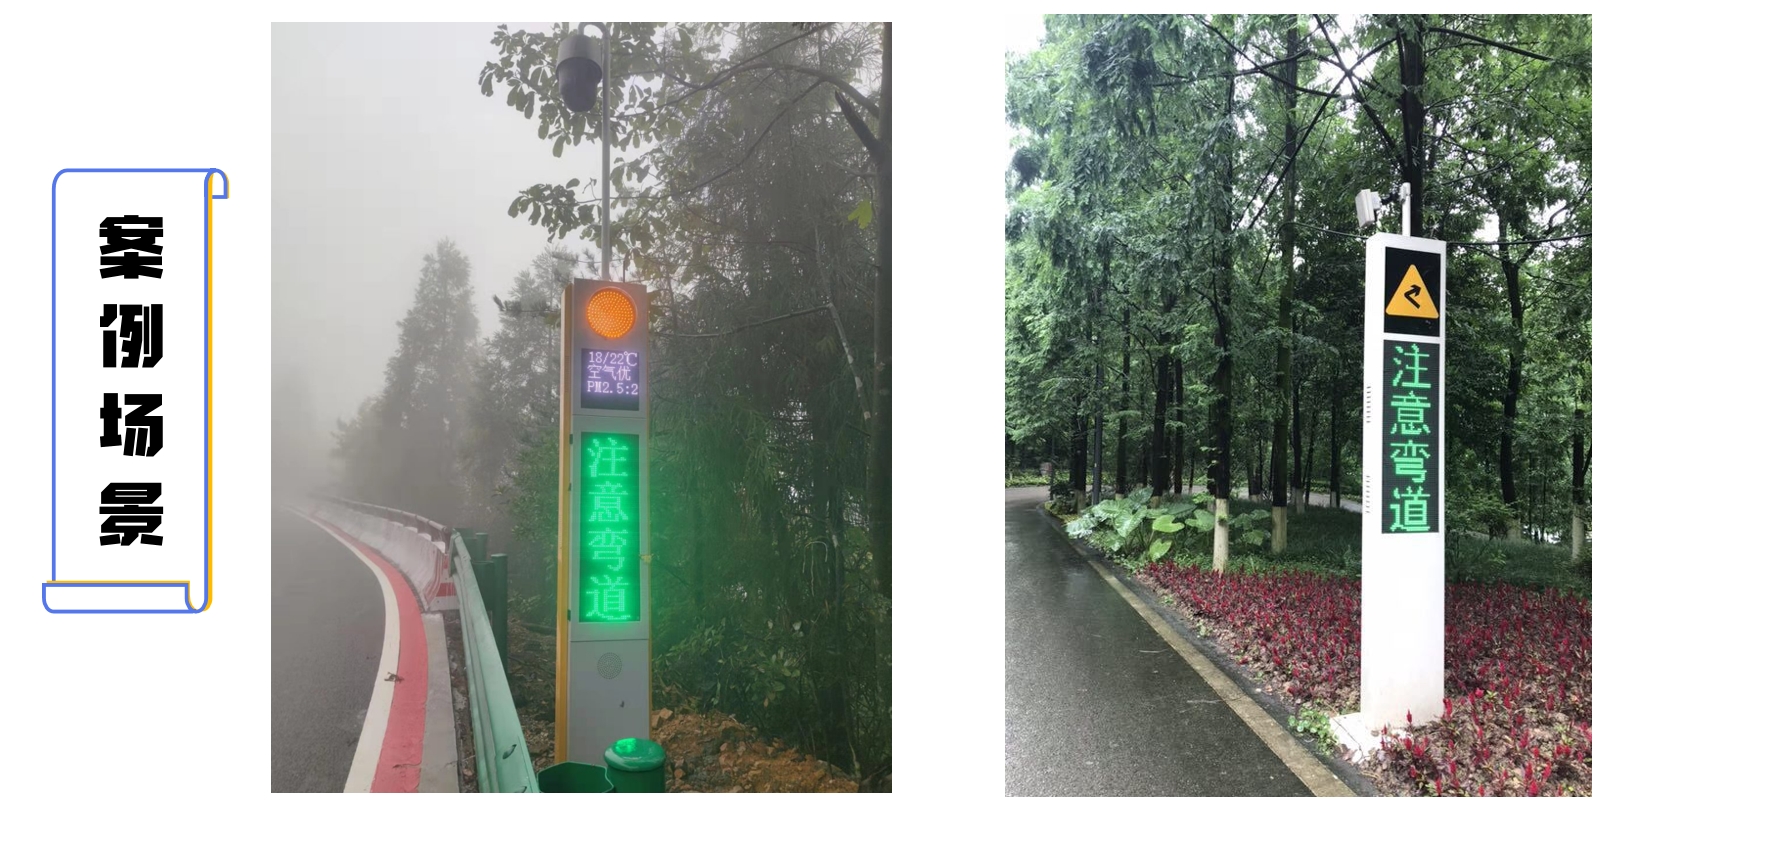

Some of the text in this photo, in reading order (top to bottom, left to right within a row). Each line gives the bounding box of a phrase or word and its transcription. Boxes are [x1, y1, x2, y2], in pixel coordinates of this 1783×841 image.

[586, 380, 639, 396] PM2.5:2
[587, 364, 631, 381] 空气优
[1389, 343, 1431, 532] 注意弯道
[586, 437, 631, 620] 注意弯道
